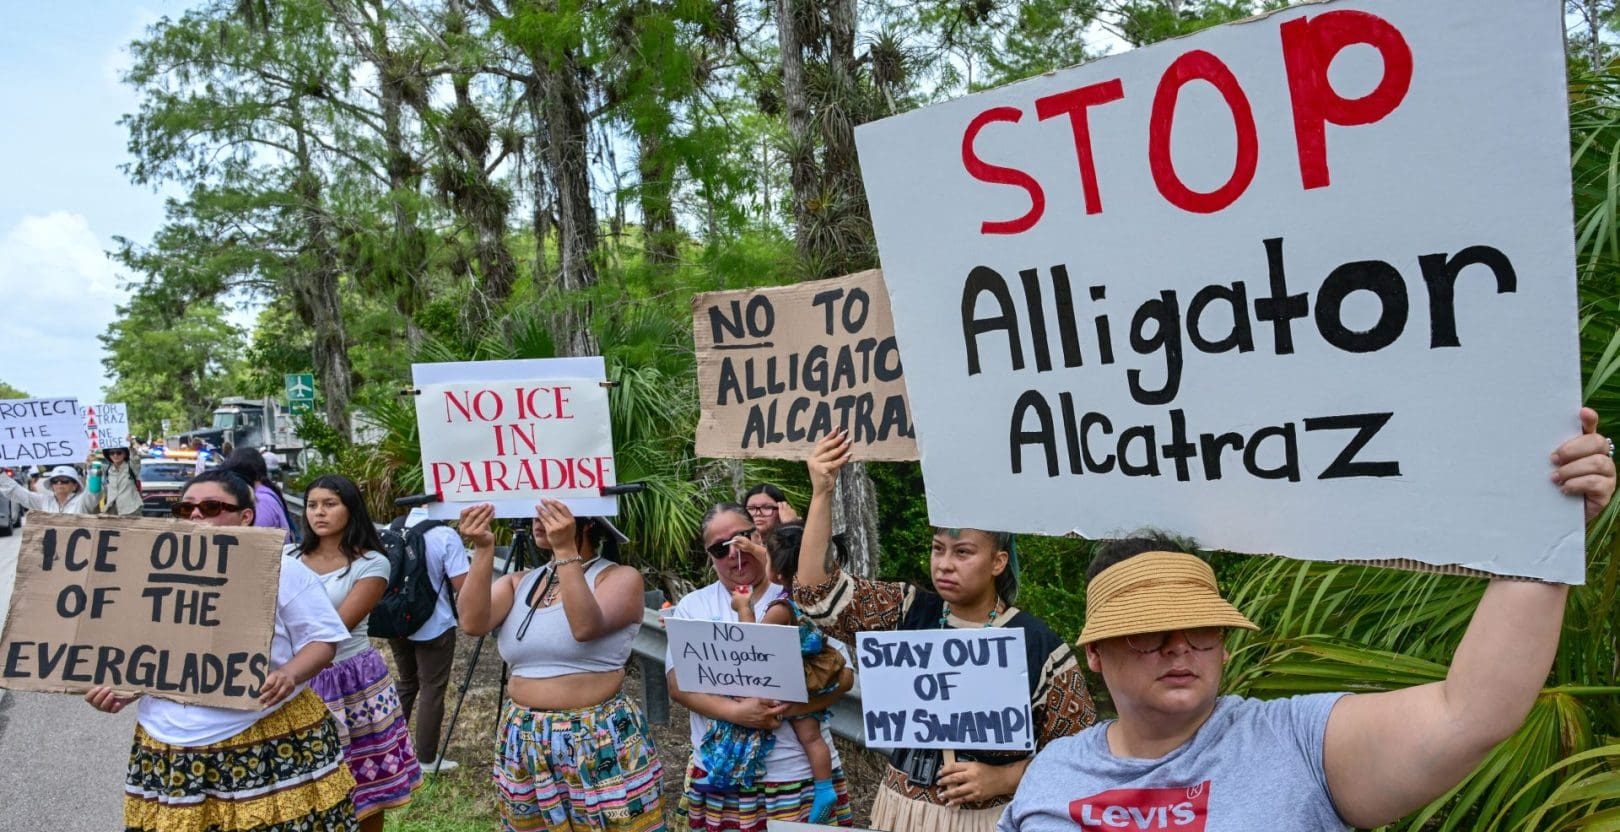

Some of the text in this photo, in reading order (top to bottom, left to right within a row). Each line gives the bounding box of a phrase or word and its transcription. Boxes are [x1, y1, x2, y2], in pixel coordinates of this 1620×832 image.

[961, 9, 1414, 235] STOP
[708, 287, 870, 343] NO TO
[961, 238, 1517, 405] Alligator
[717, 336, 904, 405] ALLIGATO
[0, 400, 78, 420] ROTECT
[444, 386, 574, 423] NO ICE
[741, 392, 916, 449] ALCATRA
[0, 440, 73, 461] LADES
[5, 424, 51, 440] THE
[493, 423, 538, 456] IN
[1010, 390, 1402, 482] Alcatraz
[431, 456, 612, 498] PARADISE
[42, 528, 239, 575] ICE OUT
[56, 584, 221, 627] OF THE
[683, 641, 776, 666] Alligator
[712, 623, 744, 643] NO
[861, 636, 1017, 669] STAY OUT
[3, 641, 268, 699] EVERGLADES
[698, 663, 781, 688] Alcatraz
[913, 671, 961, 701] OF
[865, 704, 1032, 749] MY SWAMP!
